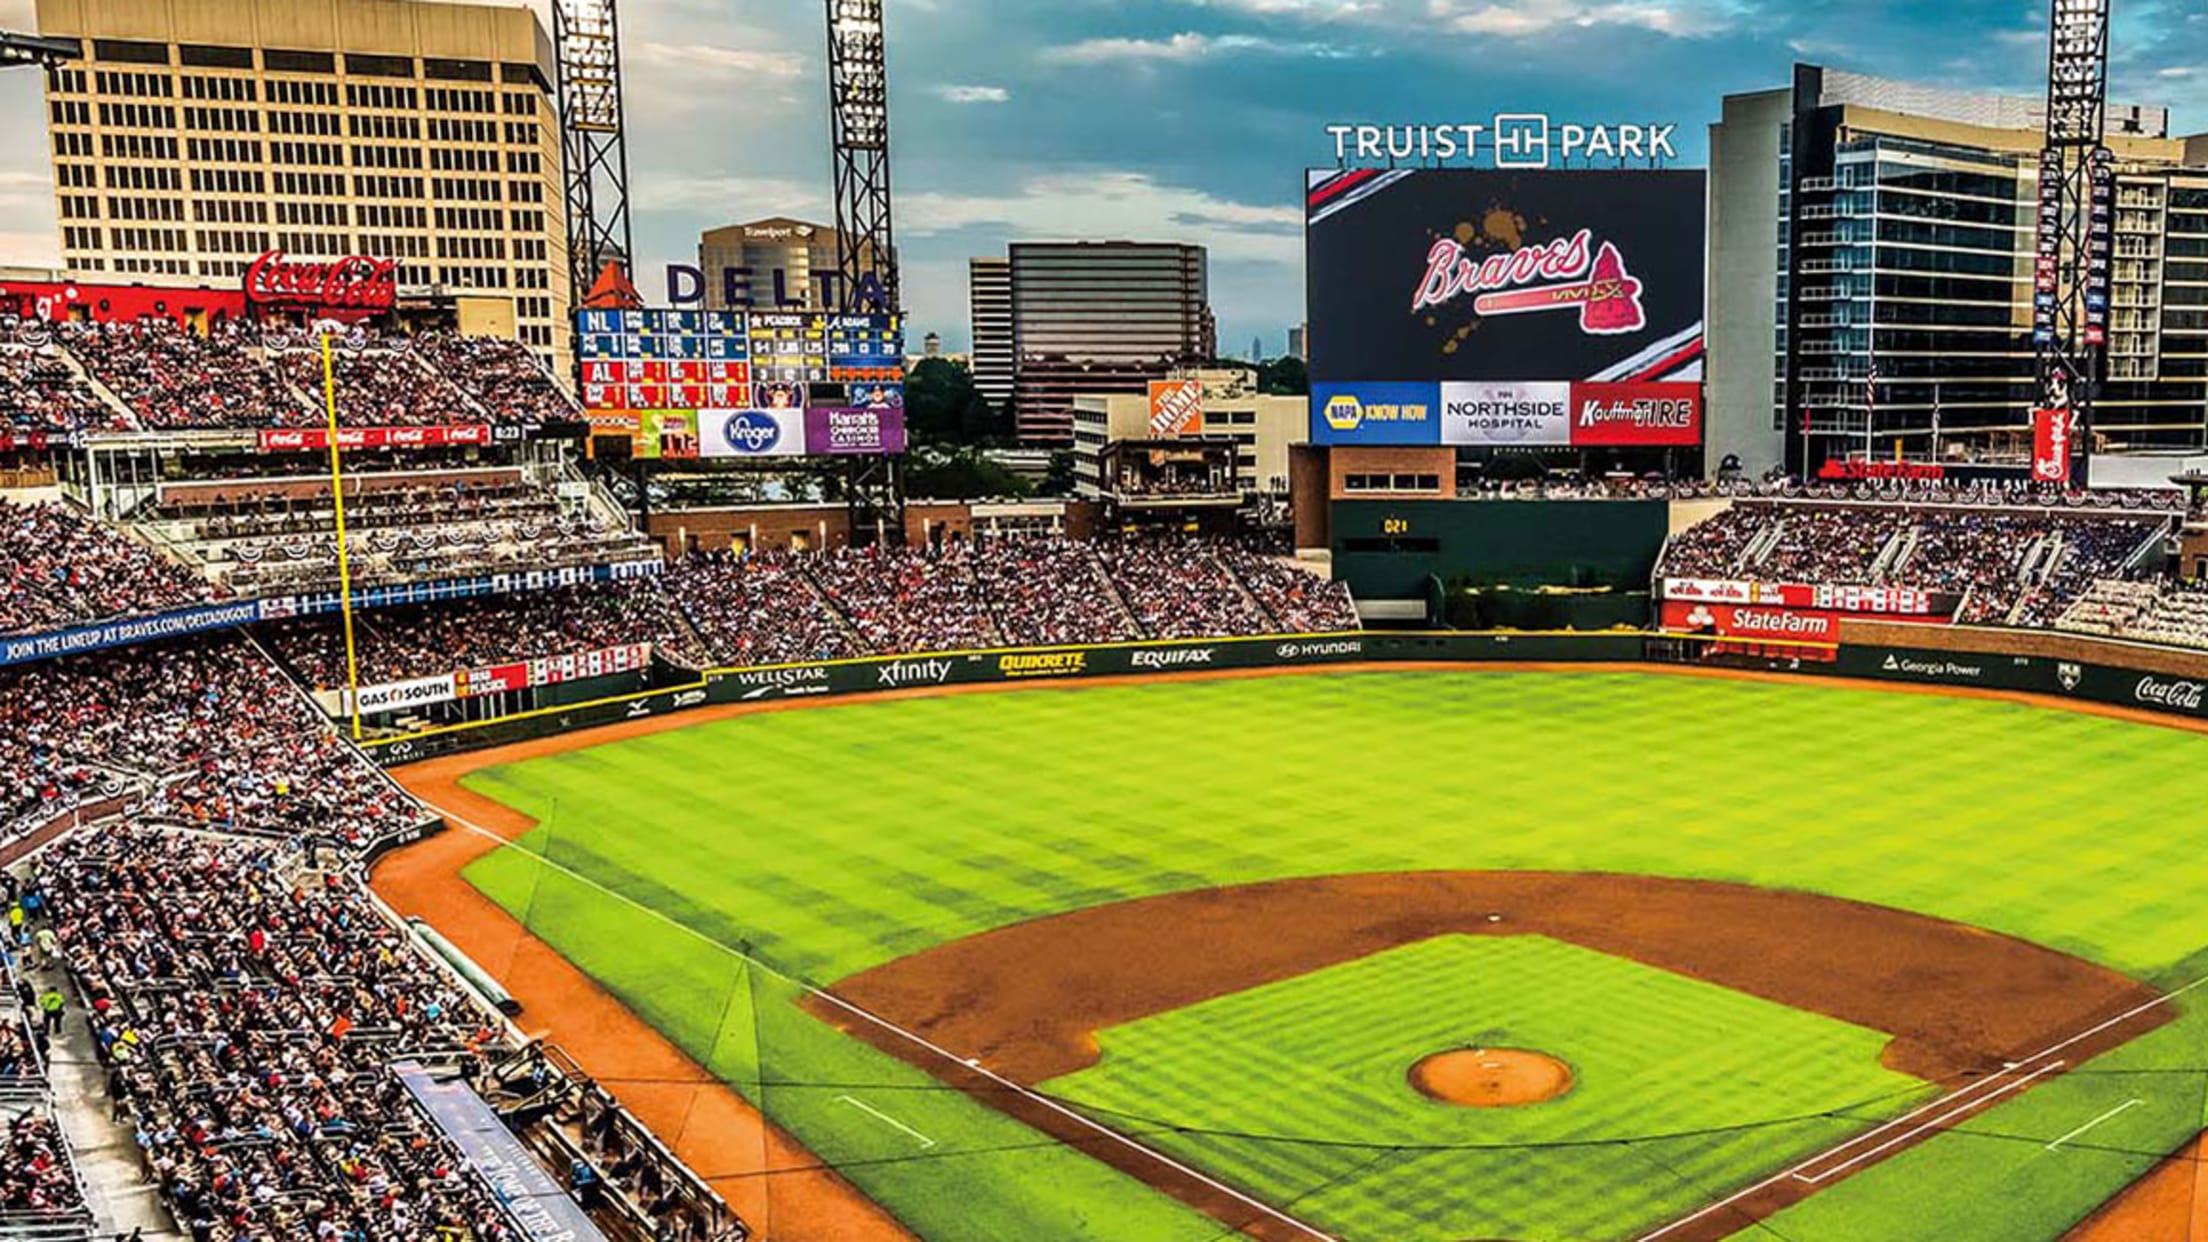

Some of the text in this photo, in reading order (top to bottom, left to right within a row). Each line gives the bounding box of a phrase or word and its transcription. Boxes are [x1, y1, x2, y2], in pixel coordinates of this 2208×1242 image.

[1326, 124, 1677, 158] TRUIST PARK
[744, 226, 792, 240] Travelport
[1412, 229, 1592, 310] Braves
[666, 264, 887, 313] DELTA
[587, 311, 611, 331] NL
[592, 363, 615, 381] AL
[1151, 380, 1201, 433] HOME
[1330, 404, 1428, 421] NAPA KNOW HOW
[1447, 402, 1564, 416] NORTHSIDE
[1632, 398, 1692, 427] TIRE
[729, 417, 775, 449] Kroger
[1468, 419, 1543, 429] HOSPITAL
[6, 641, 34, 660] JOIN
[37, 636, 59, 653] THE
[61, 630, 100, 649] LINEUP
[102, 627, 118, 643] AT
[1302, 643, 1361, 656] HYUNDAI
[999, 652, 1085, 669] QUIKRETE
[1131, 649, 1214, 668] EQUIFAX
[1901, 658, 1981, 676] Georgia Power
[739, 668, 829, 684] WELLSTAR
[877, 658, 952, 686] xfinity
[359, 682, 449, 707] GAS SOUTH
